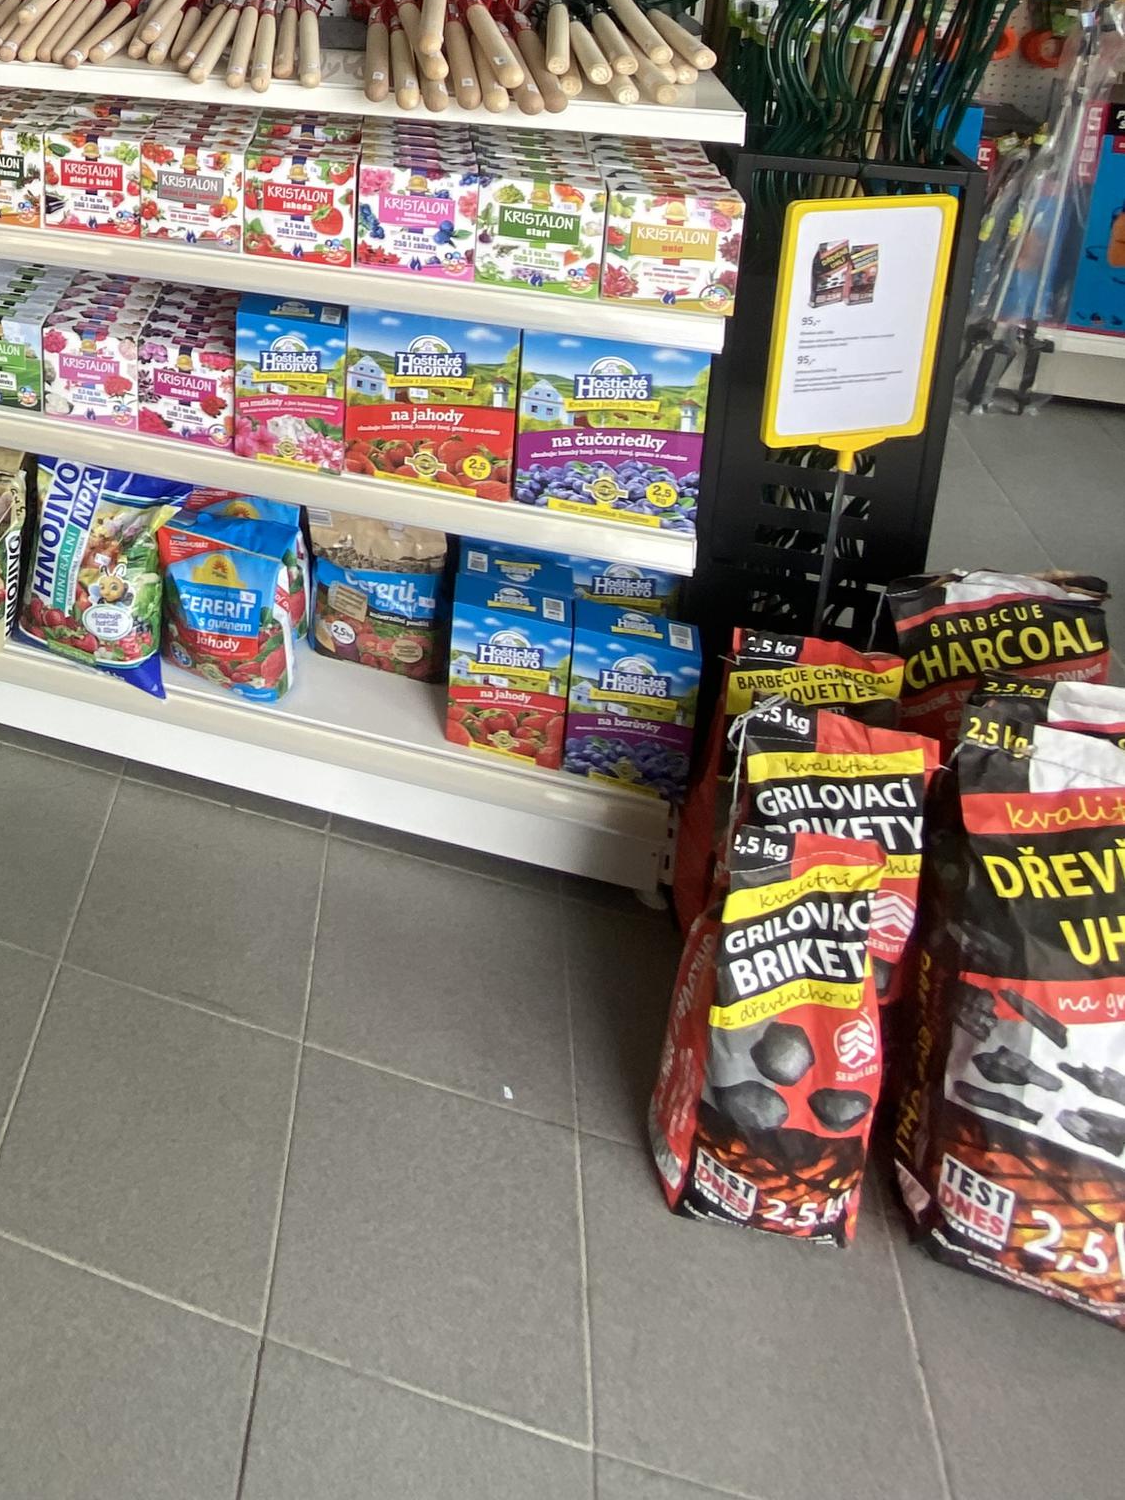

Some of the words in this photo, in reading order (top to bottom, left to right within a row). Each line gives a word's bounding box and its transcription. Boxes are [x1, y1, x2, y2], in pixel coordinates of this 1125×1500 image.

[64, 161, 118, 178] KRISTALON
[161, 174, 219, 192] KRISTALON
[267, 186, 329, 203] KRISTALON
[383, 197, 450, 215] KRISTALON
[503, 210, 574, 230] KRISTALON
[525, 228, 551, 238] start
[636, 227, 710, 245] KRISTALON
[62, 357, 115, 373] KRISTALON
[261, 351, 318, 367] Hoštické
[396, 353, 463, 369] Hoštické
[157, 373, 212, 392] KRISTALON
[575, 375, 649, 392] Hoštické
[391, 409, 410, 422] na
[411, 407, 465, 426] jahody
[551, 436, 572, 448] na
[575, 432, 668, 453] čučoriedky
[74, 471, 102, 527] NPK
[33, 462, 81, 598] HNOJIVO
[344, 570, 418, 603] Cererit
[594, 577, 652, 591] Hoštické
[180, 592, 255, 620] CERERIT
[198, 617, 205, 627] s
[929, 603, 1044, 639] BARBECUE
[478, 644, 541, 661] Hoštické
[775, 641, 797, 656] kg
[904, 617, 1104, 691] CHARCOAL
[600, 670, 668, 689] Hoštické
[736, 669, 809, 690] BARBECUE
[813, 667, 894, 686] CHARCOAL
[479, 690, 493, 698] na
[495, 689, 532, 704] jahody
[772, 682, 879, 704] IQUETTES
[1020, 684, 1047, 699] kg
[597, 717, 612, 726] na
[614, 716, 662, 734] borůvky
[786, 709, 811, 735] kg
[965, 716, 1000, 745] 2,5
[785, 757, 886, 774] kvalitní
[756, 778, 917, 817] GRILOVACÍ
[762, 838, 789, 862] kg
[1059, 916, 1125, 966] UH
[729, 938, 869, 996] BRIKET
[740, 982, 838, 1023] dřevěného
[1058, 994, 1099, 1012] na
[699, 1150, 756, 1198] TEST
[698, 1164, 750, 1213] DNES
[945, 1157, 1012, 1214] TEST
[941, 1186, 1006, 1240] DNES
